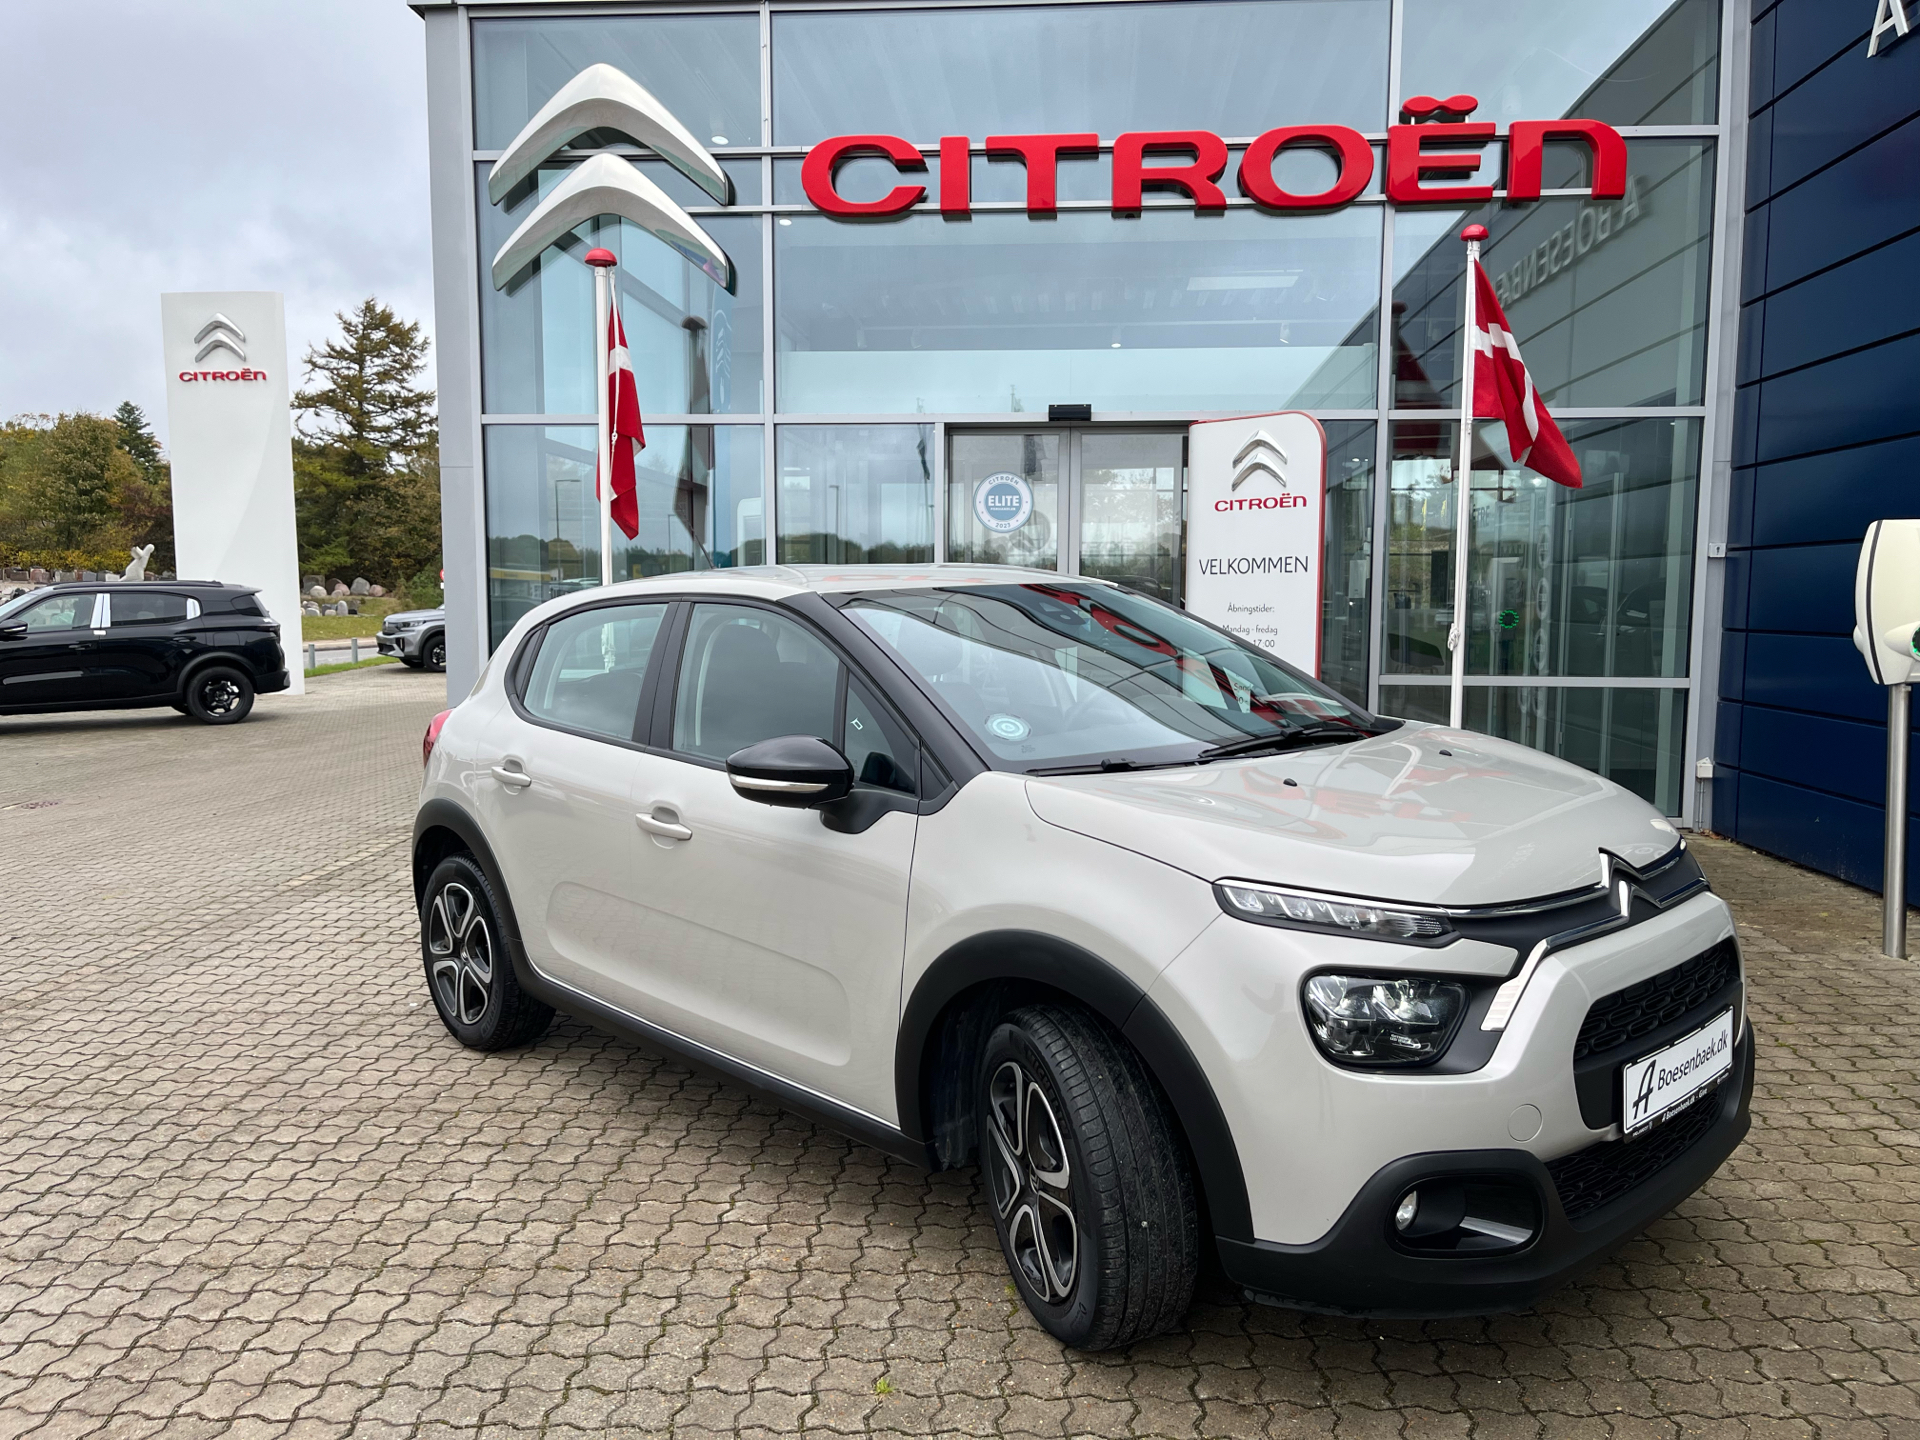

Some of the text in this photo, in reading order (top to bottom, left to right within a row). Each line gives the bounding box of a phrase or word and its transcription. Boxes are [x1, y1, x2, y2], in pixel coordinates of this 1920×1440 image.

[801, 94, 1628, 218] CITROËN
[179, 367, 267, 382] CITROËN
[988, 495, 1020, 507] ELITE
[1214, 493, 1308, 512] CITROËN
[1199, 555, 1309, 576] VELKOMMEN
[1227, 602, 1275, 615] Åbningstider:
[1255, 624, 1278, 636] fredag
[1657, 1029, 1729, 1091] Boesenbaek.dk
